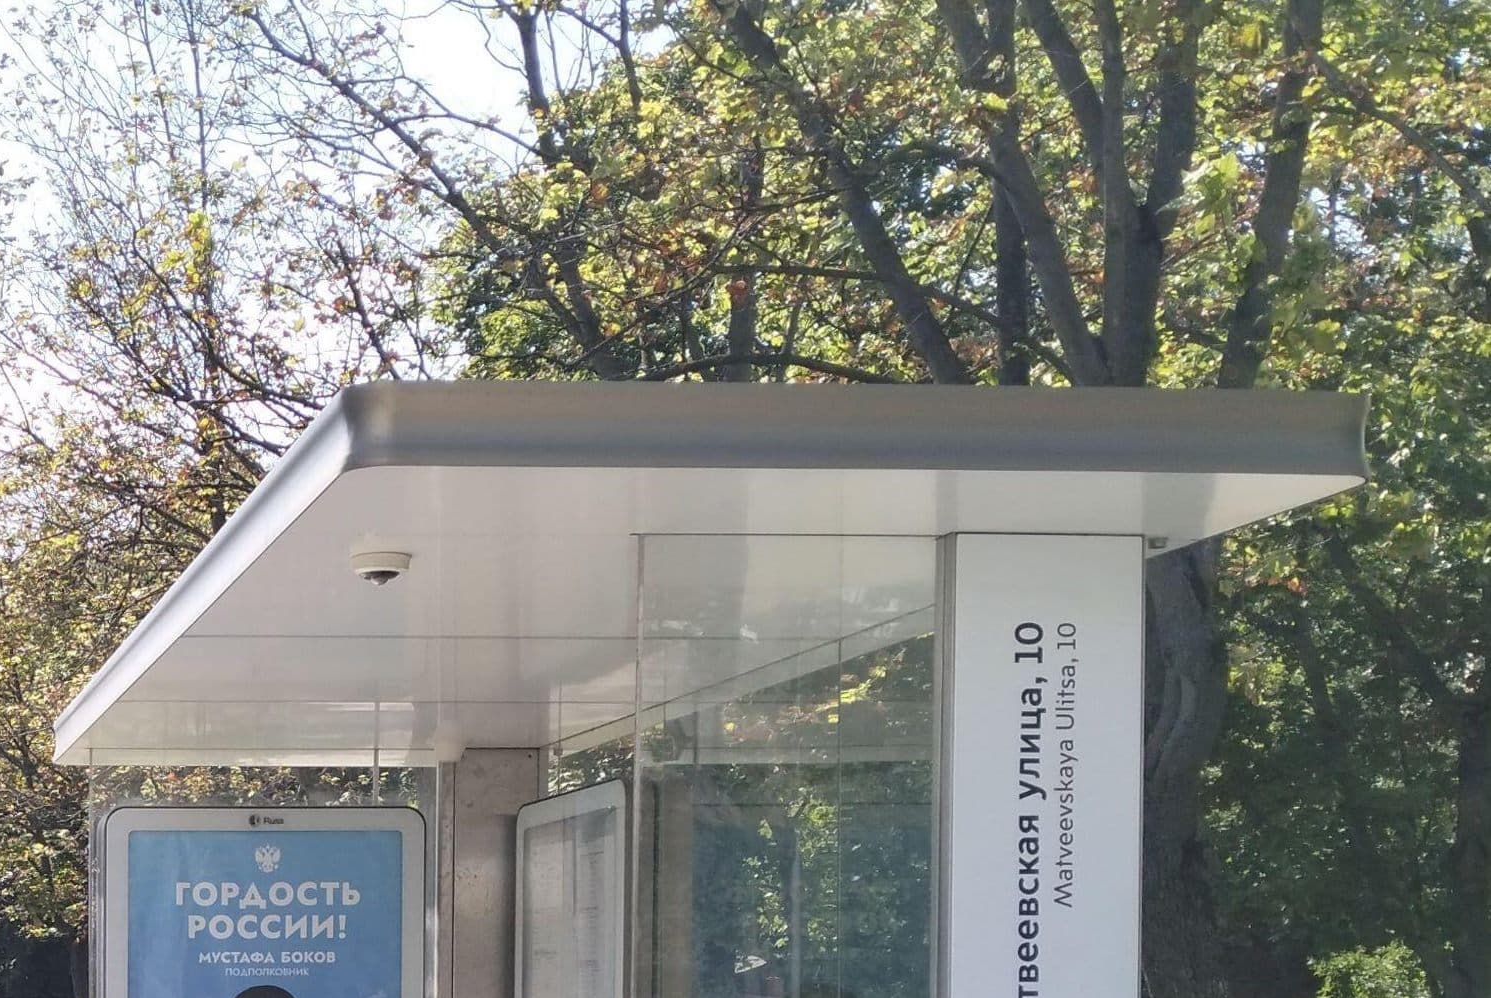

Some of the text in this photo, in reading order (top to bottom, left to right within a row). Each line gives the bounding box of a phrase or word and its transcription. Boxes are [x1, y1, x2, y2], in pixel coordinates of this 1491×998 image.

[1014, 622, 1044, 664] 10
[1018, 677, 1048, 801] улица,
[1054, 622, 1080, 908] Matveevskaya Ulitsa, 10
[175, 881, 361, 910] ГОРДОСТЬ
[187, 914, 347, 940] РОССИИ!
[198, 951, 336, 964] МУСТАФА БОКОВ
[224, 967, 309, 977] ПОДПОЛКОВНИК
